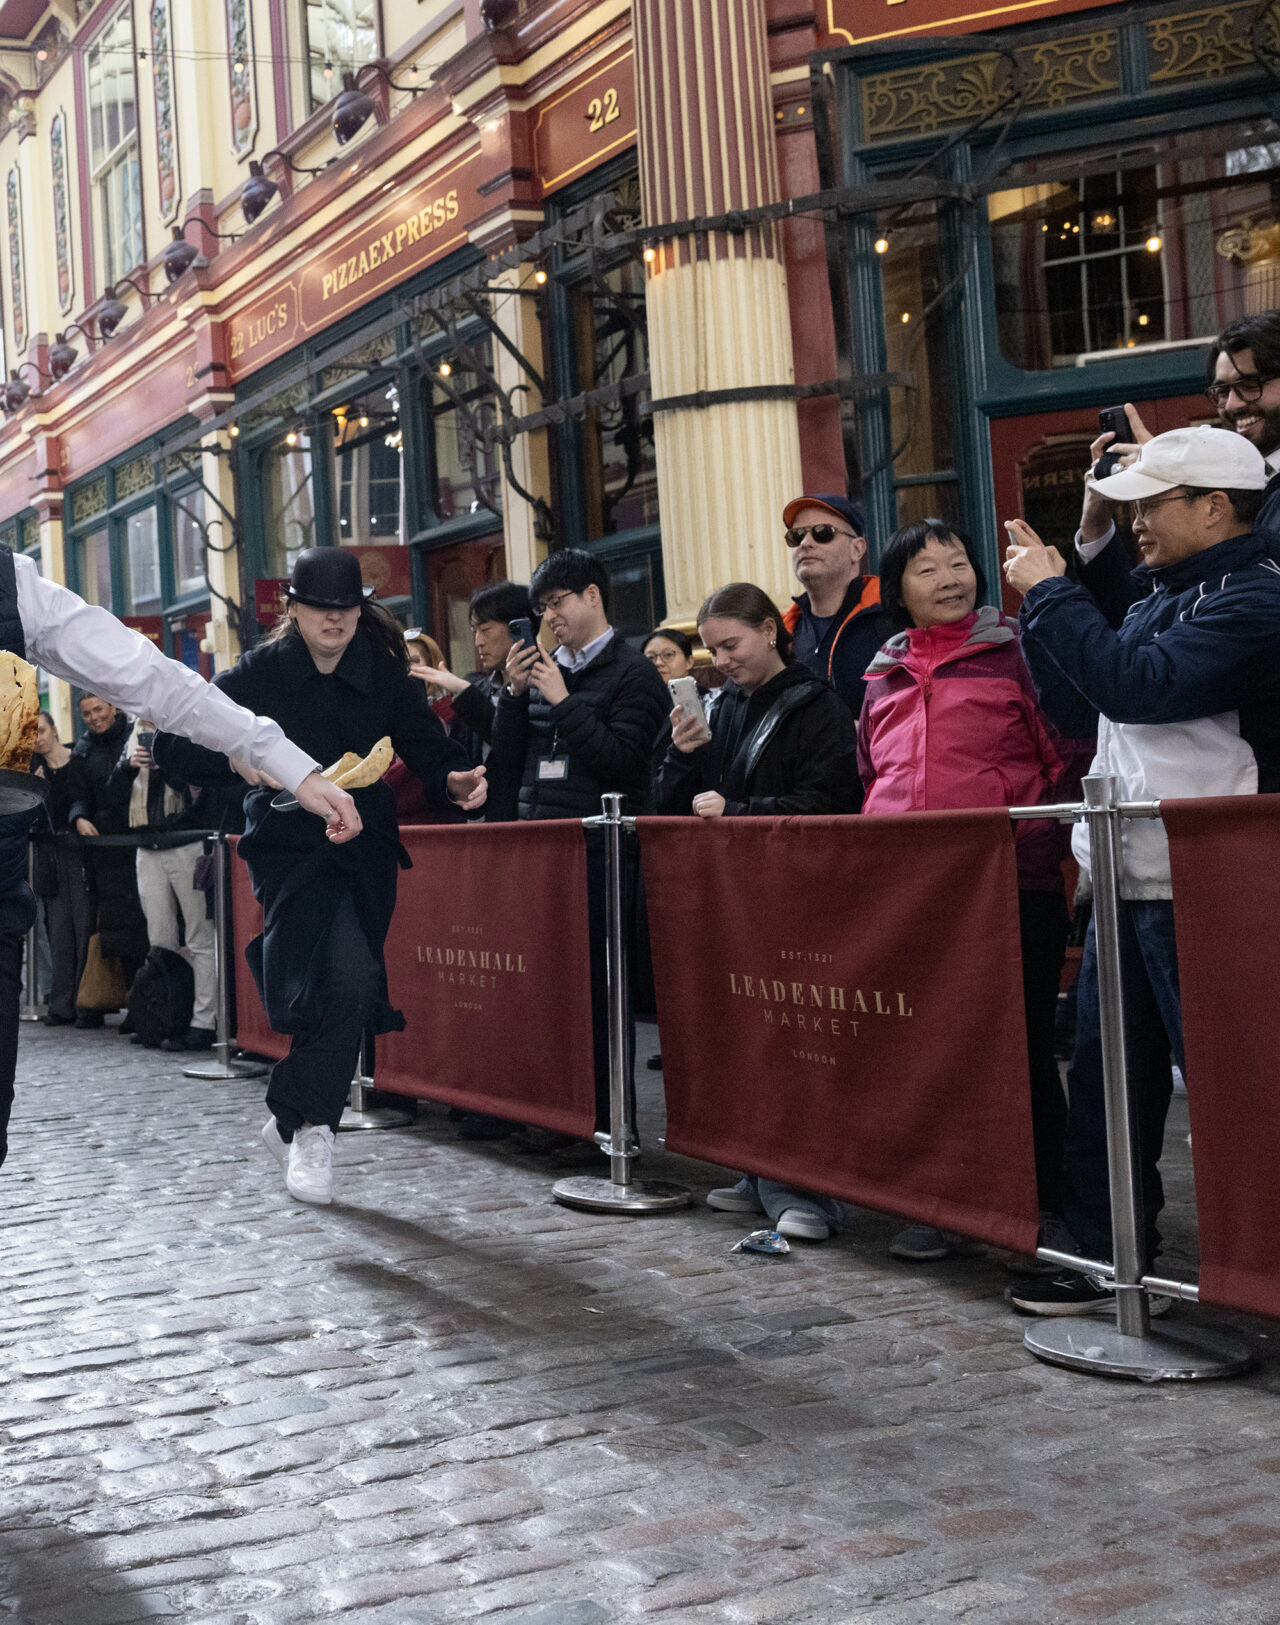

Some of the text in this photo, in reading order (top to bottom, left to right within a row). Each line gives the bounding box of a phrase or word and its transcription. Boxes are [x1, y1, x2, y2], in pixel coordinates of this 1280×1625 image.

[588, 88, 620, 132] 22
[322, 189, 459, 300] PIZZAEXPRESS
[249, 302, 288, 348] LUC'S
[418, 946, 526, 973] LEADENHALL
[781, 950, 833, 963] EST.1321
[438, 971, 497, 989] MARKET
[729, 973, 913, 1017] LEADENHALL
[764, 1009, 859, 1037] MARKET
[792, 1049, 836, 1065] LONDON
